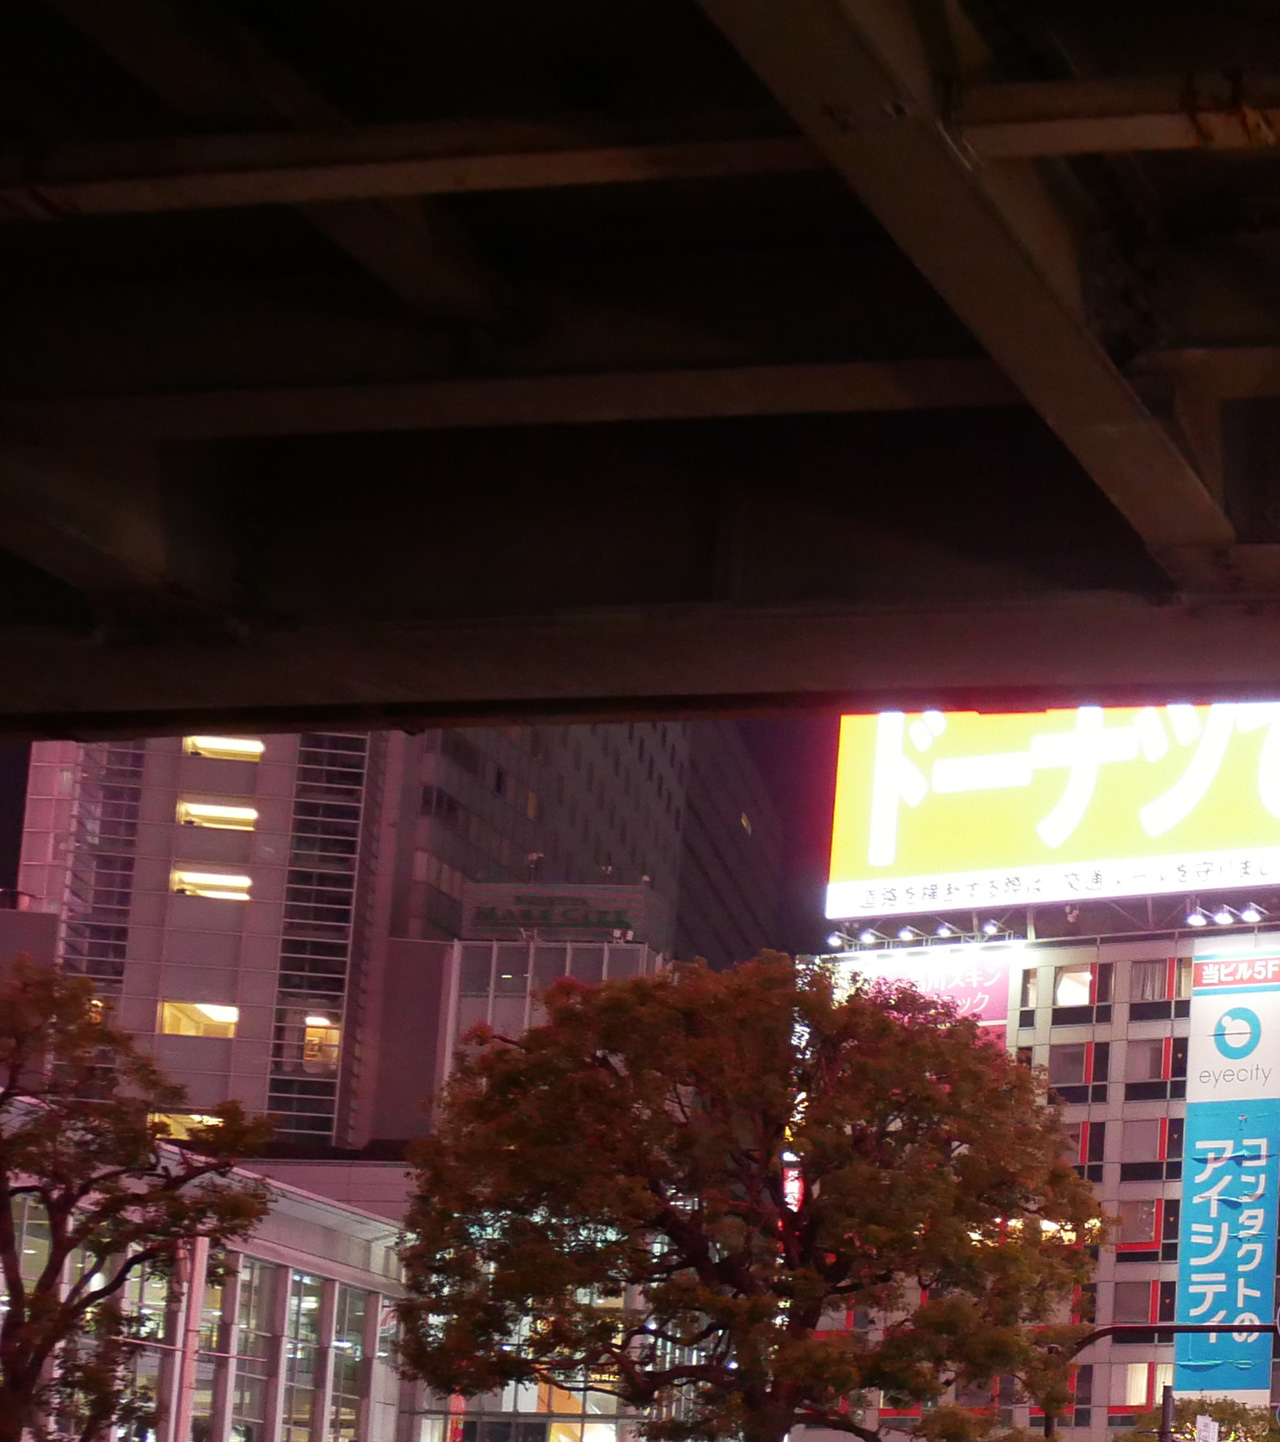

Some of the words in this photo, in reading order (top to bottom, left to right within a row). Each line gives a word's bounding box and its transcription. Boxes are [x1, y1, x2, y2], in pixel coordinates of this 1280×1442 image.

[1201, 961, 1280, 985] 当ビル5F
[1198, 1064, 1273, 1085] eyecity
[1188, 1138, 1235, 1344] アイシティ
[1232, 1138, 1268, 1344] コンタクトの
